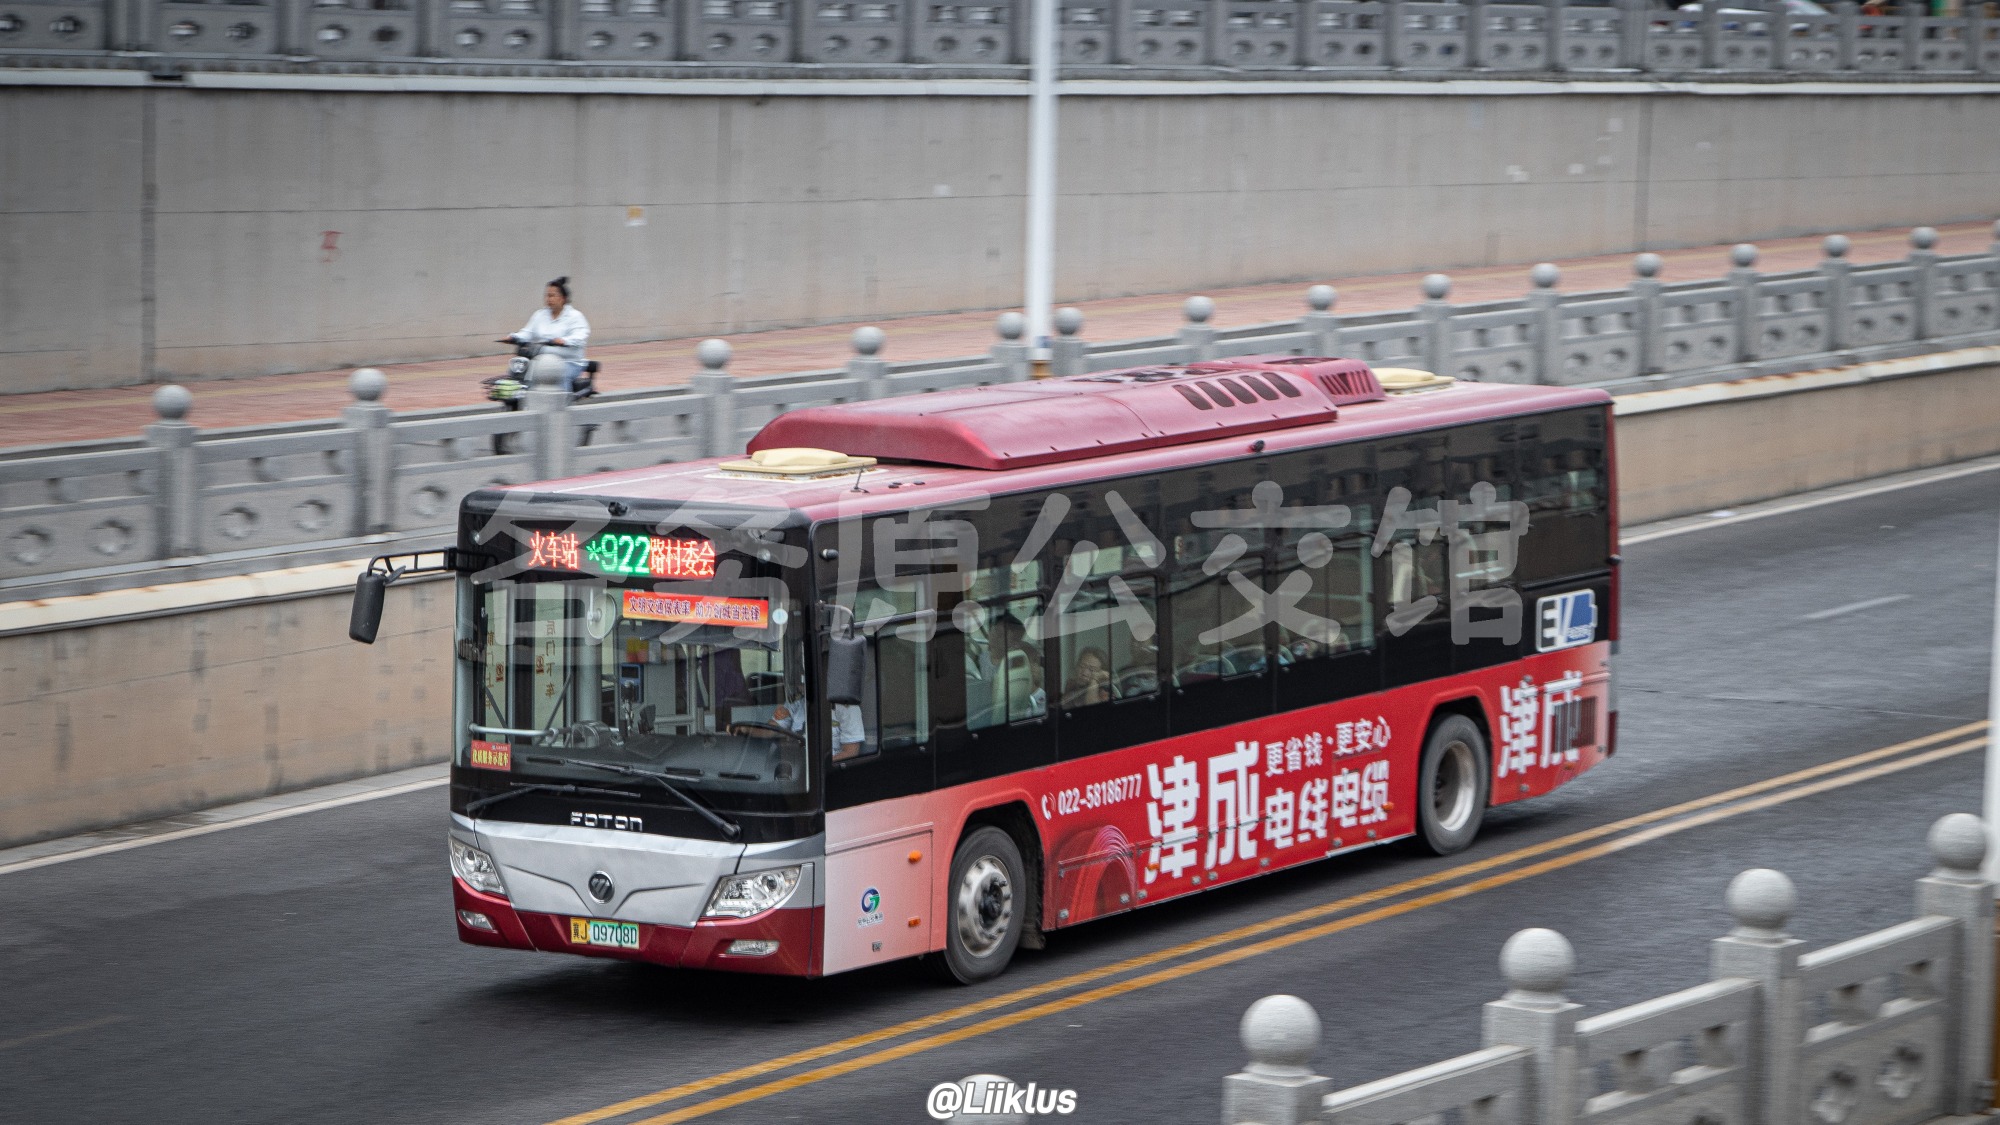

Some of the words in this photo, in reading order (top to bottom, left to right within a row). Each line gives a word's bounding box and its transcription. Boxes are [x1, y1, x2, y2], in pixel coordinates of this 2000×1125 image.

[529, 531, 578, 568] 火车站
[1058, 774, 1142, 815] 022-58186777
[1144, 741, 1259, 884] 津成
[1264, 760, 1391, 849] 电线电缆
[571, 811, 643, 832] FOTON
